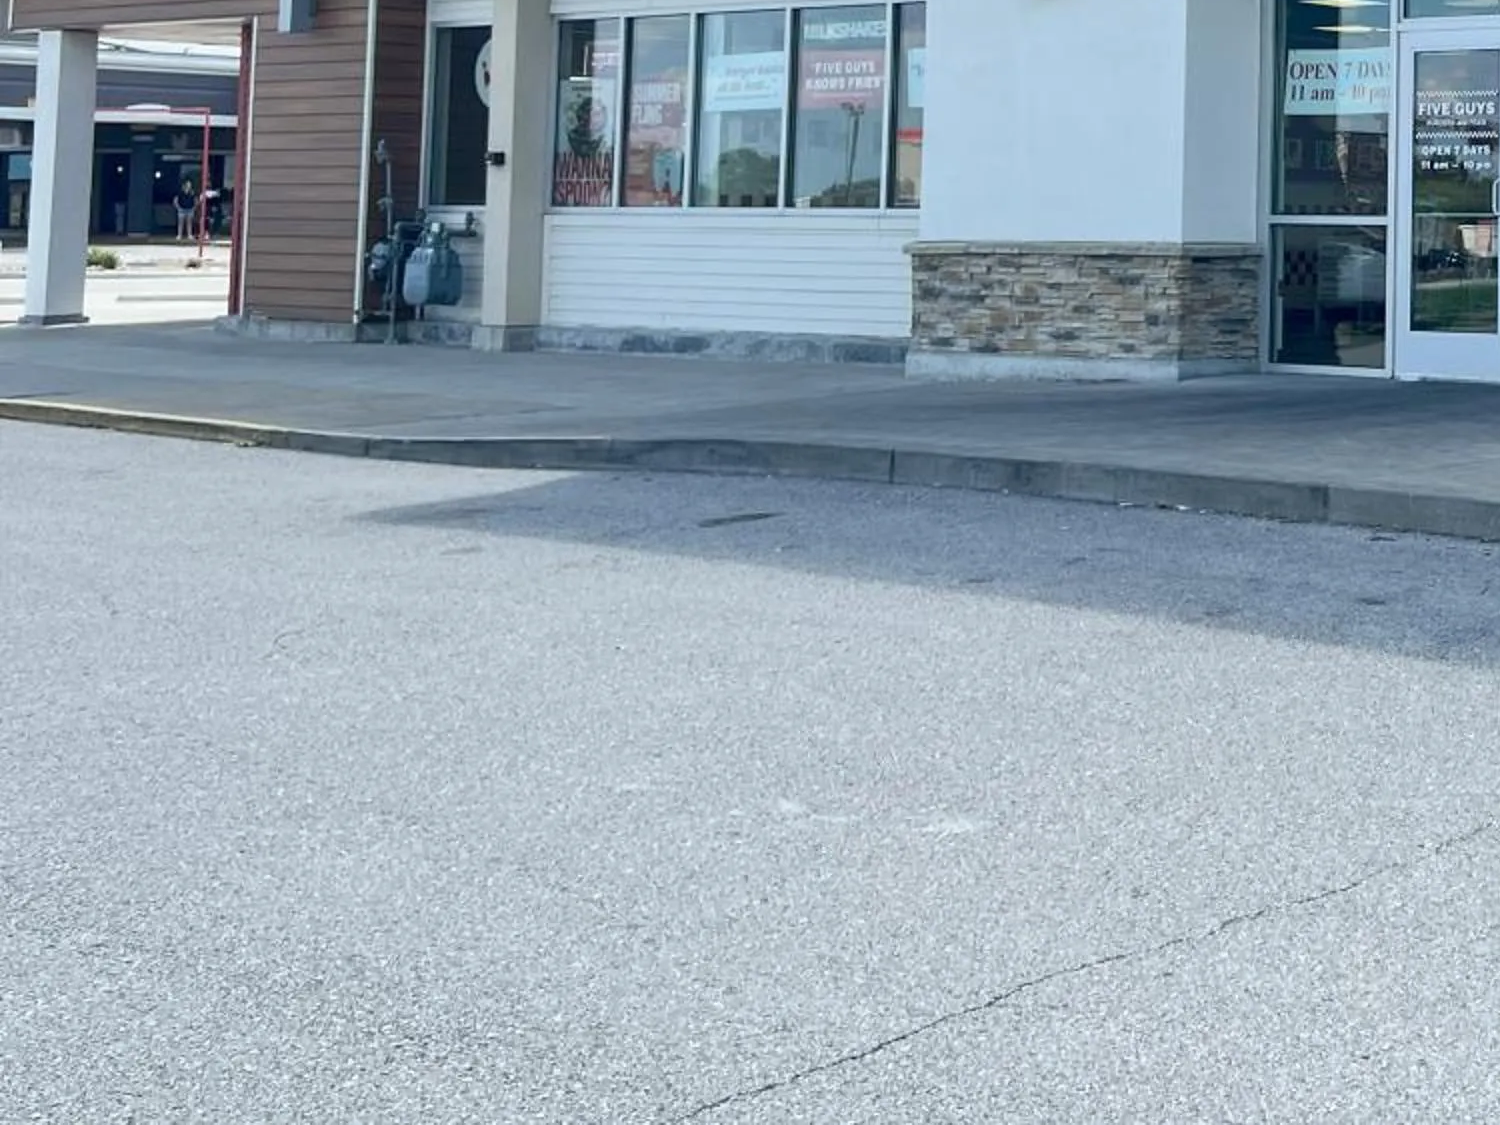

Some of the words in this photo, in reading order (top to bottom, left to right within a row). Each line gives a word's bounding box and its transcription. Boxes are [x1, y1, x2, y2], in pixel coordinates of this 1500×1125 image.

[1290, 61, 1338, 80] OPEN
[1344, 61, 1353, 79] 7
[1292, 84, 1305, 101] 11
[1310, 87, 1335, 101] am
[1418, 102, 1450, 116] FIVE
[1454, 102, 1496, 115] GUYS
